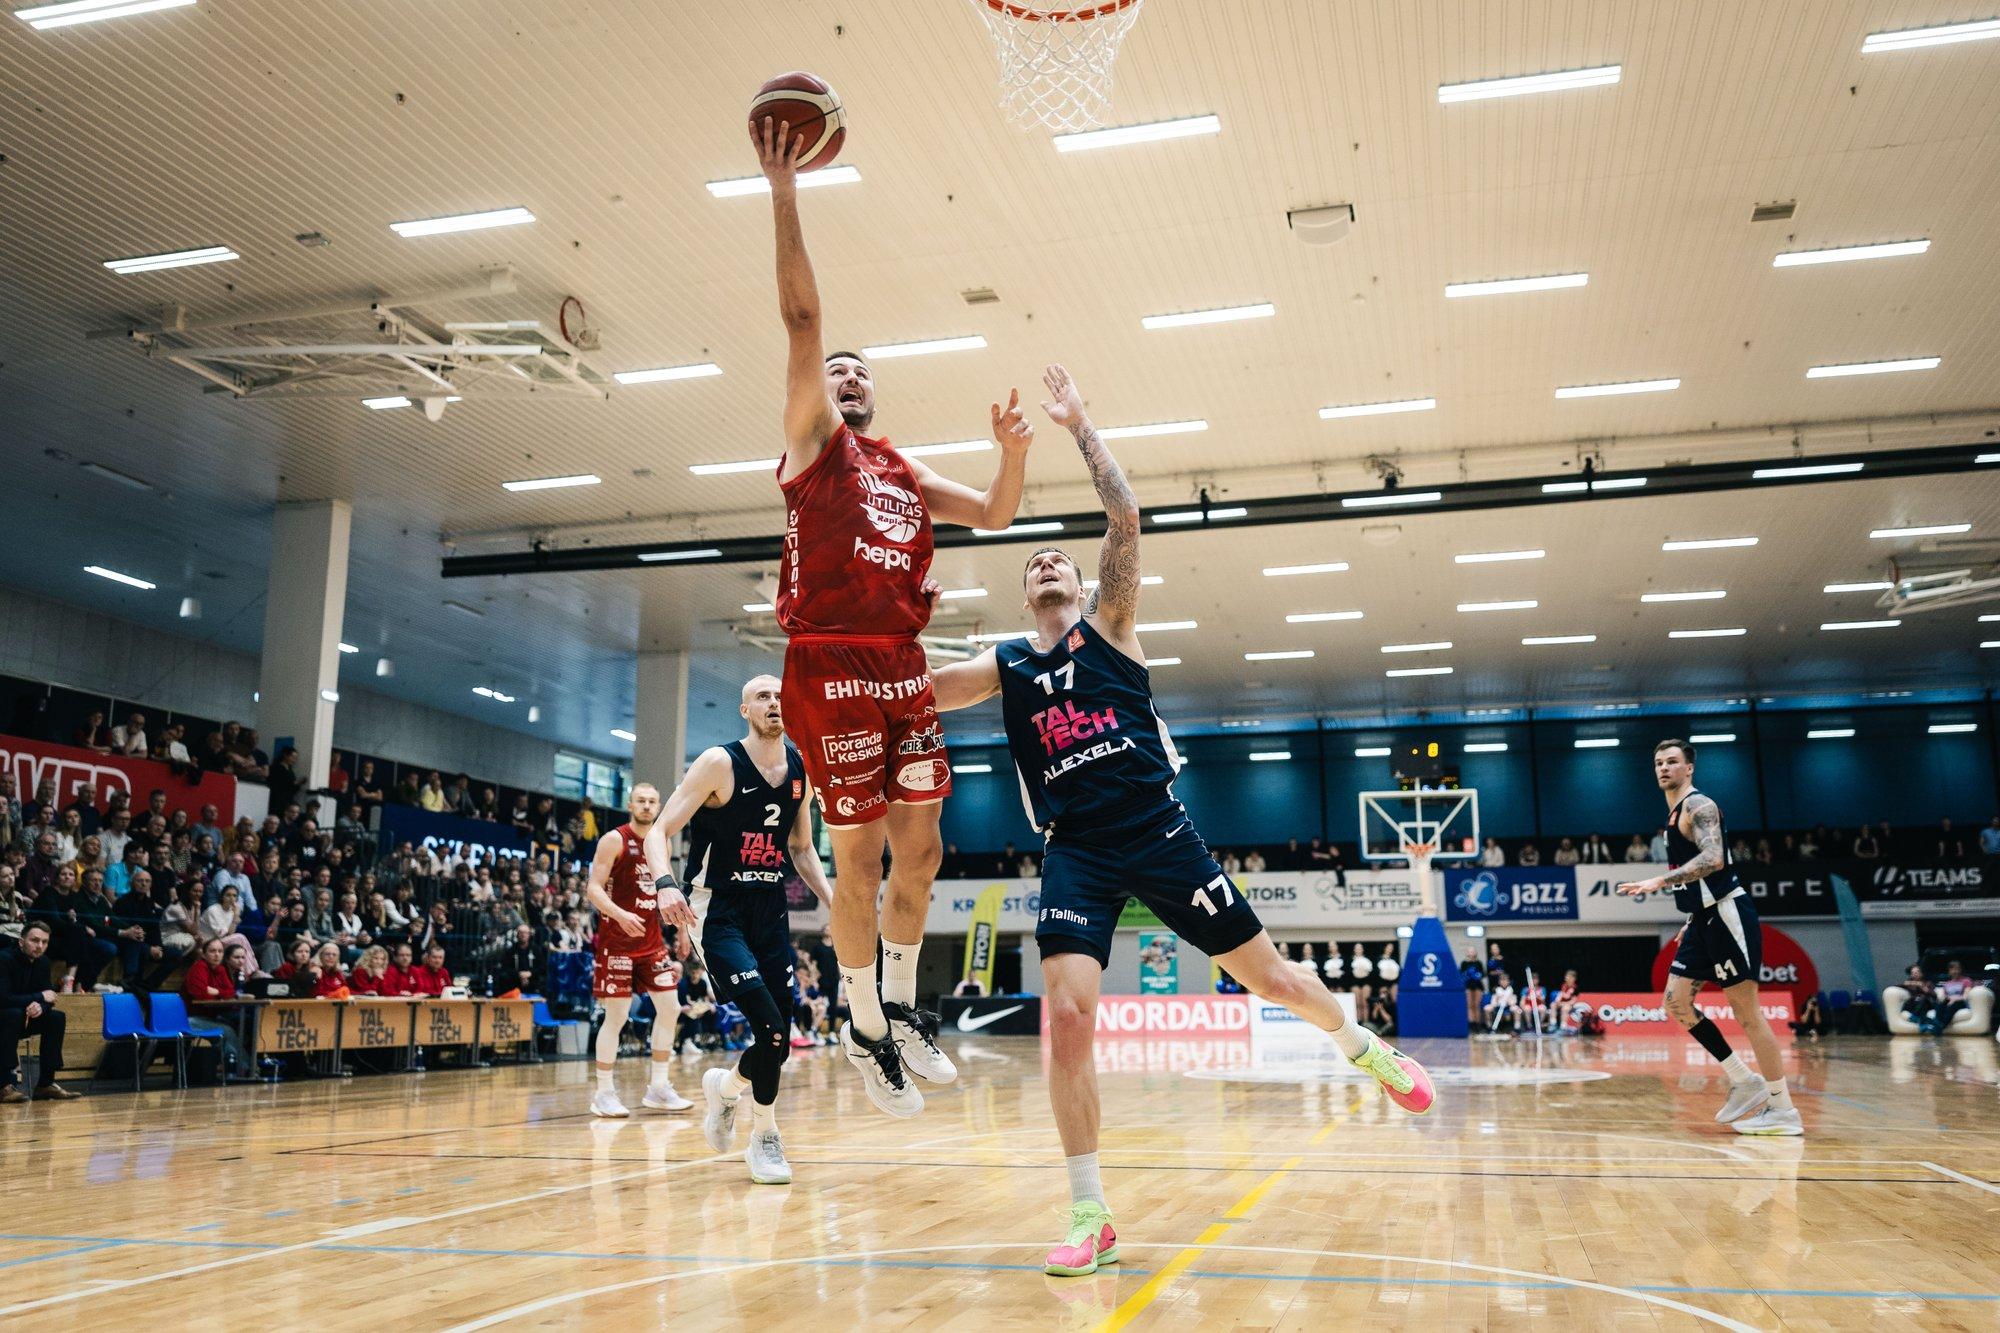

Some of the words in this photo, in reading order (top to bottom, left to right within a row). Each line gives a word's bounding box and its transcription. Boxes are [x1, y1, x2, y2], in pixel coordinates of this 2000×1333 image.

[867, 493, 923, 518] UTILITAS
[877, 514, 903, 526] Rapla
[854, 537, 911, 571] hepa
[1033, 660, 1075, 695] 17
[1031, 700, 1085, 736] TAL
[1040, 707, 1119, 756] TECH
[1043, 736, 1136, 785] ALEXELA
[764, 803, 781, 826] 2
[742, 832, 775, 850] TAL
[1906, 867, 1982, 886] TEAMS
[1191, 873, 1235, 916] 17
[1510, 882, 1569, 911] jazz
[1050, 908, 1088, 926] Tallinn
[885, 949, 902, 961] 23
[1714, 959, 1738, 981] 41
[1759, 963, 1798, 982] bet
[278, 1008, 305, 1028] TAL
[360, 1008, 384, 1027] TAL
[1096, 1001, 1248, 1031] NORDAID
[1598, 1004, 1668, 1025] Optibet
[276, 1029, 318, 1049] TECH
[358, 1027, 395, 1045] TECH
